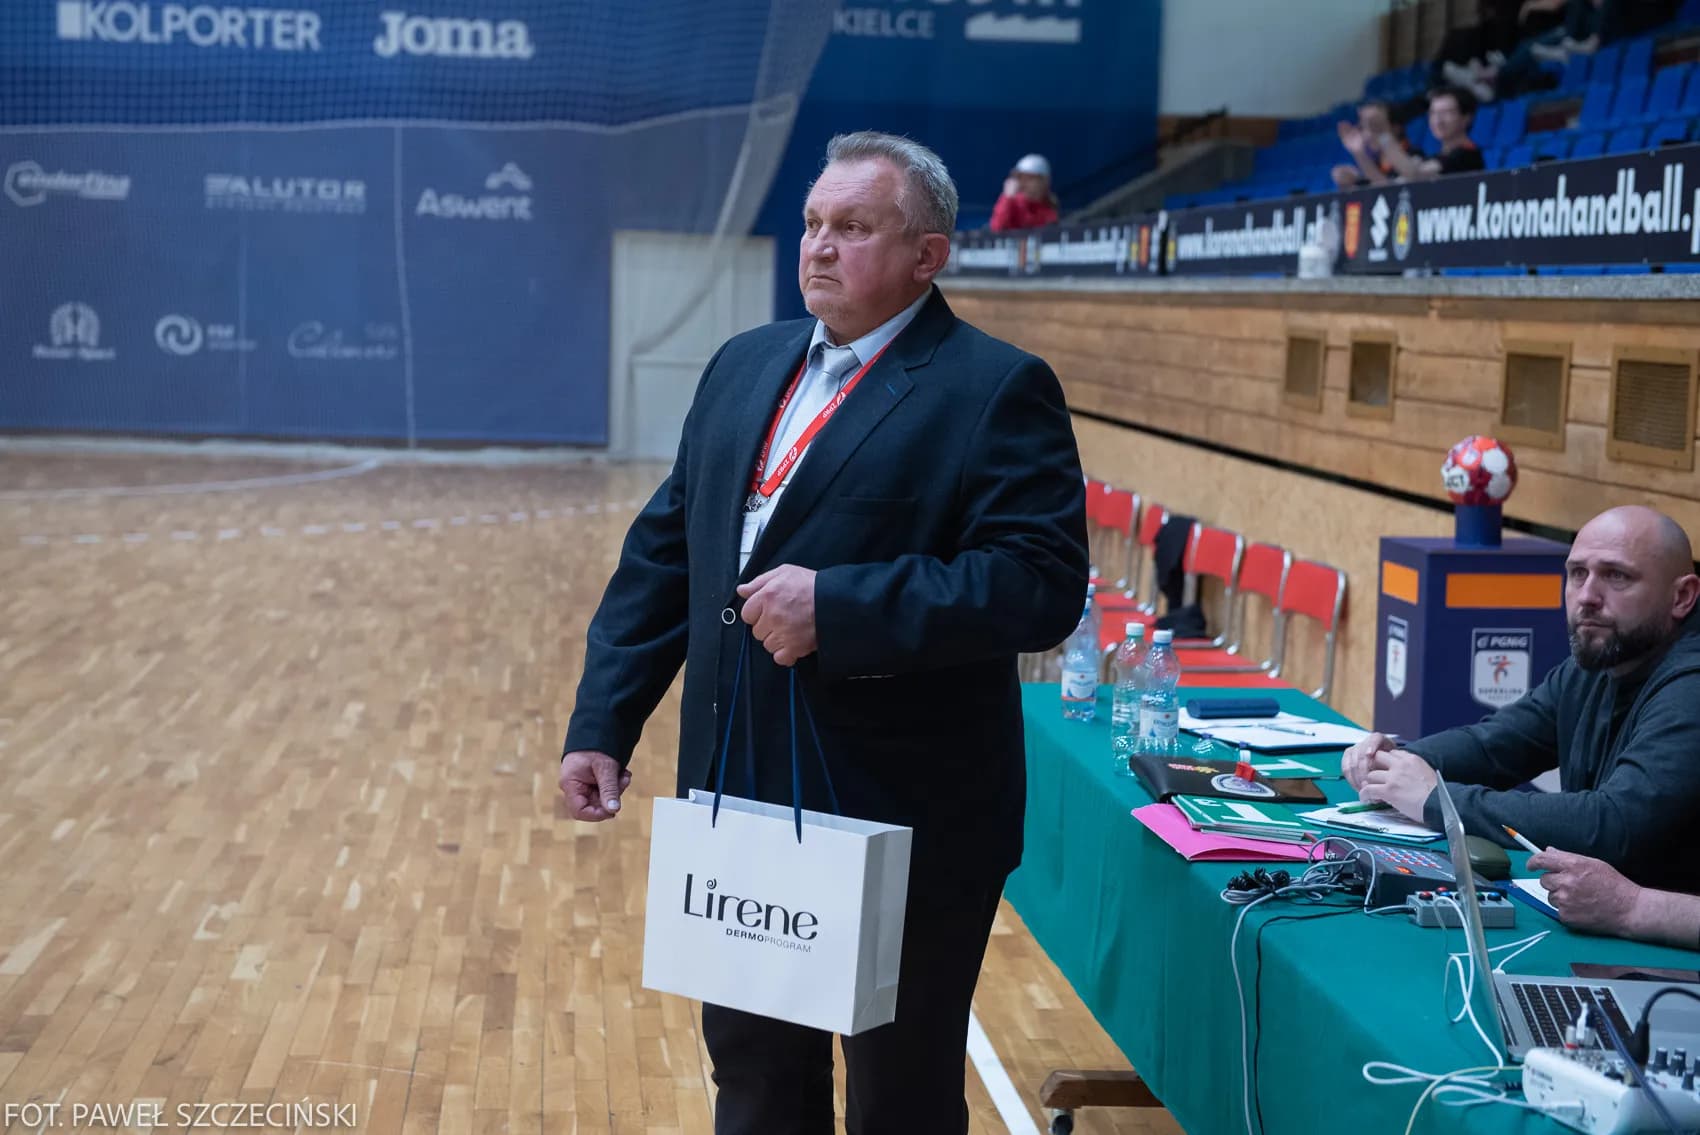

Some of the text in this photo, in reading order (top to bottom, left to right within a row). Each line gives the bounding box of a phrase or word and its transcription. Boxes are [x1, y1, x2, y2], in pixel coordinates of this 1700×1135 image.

[84, 1, 322, 52] KOLPORTER
[374, 10, 535, 60] Joma
[832, 8, 935, 39] KIELCE
[415, 188, 534, 220] Aswent
[683, 873, 819, 941] Lirene
[726, 927, 812, 953] DERMOPROGRAM
